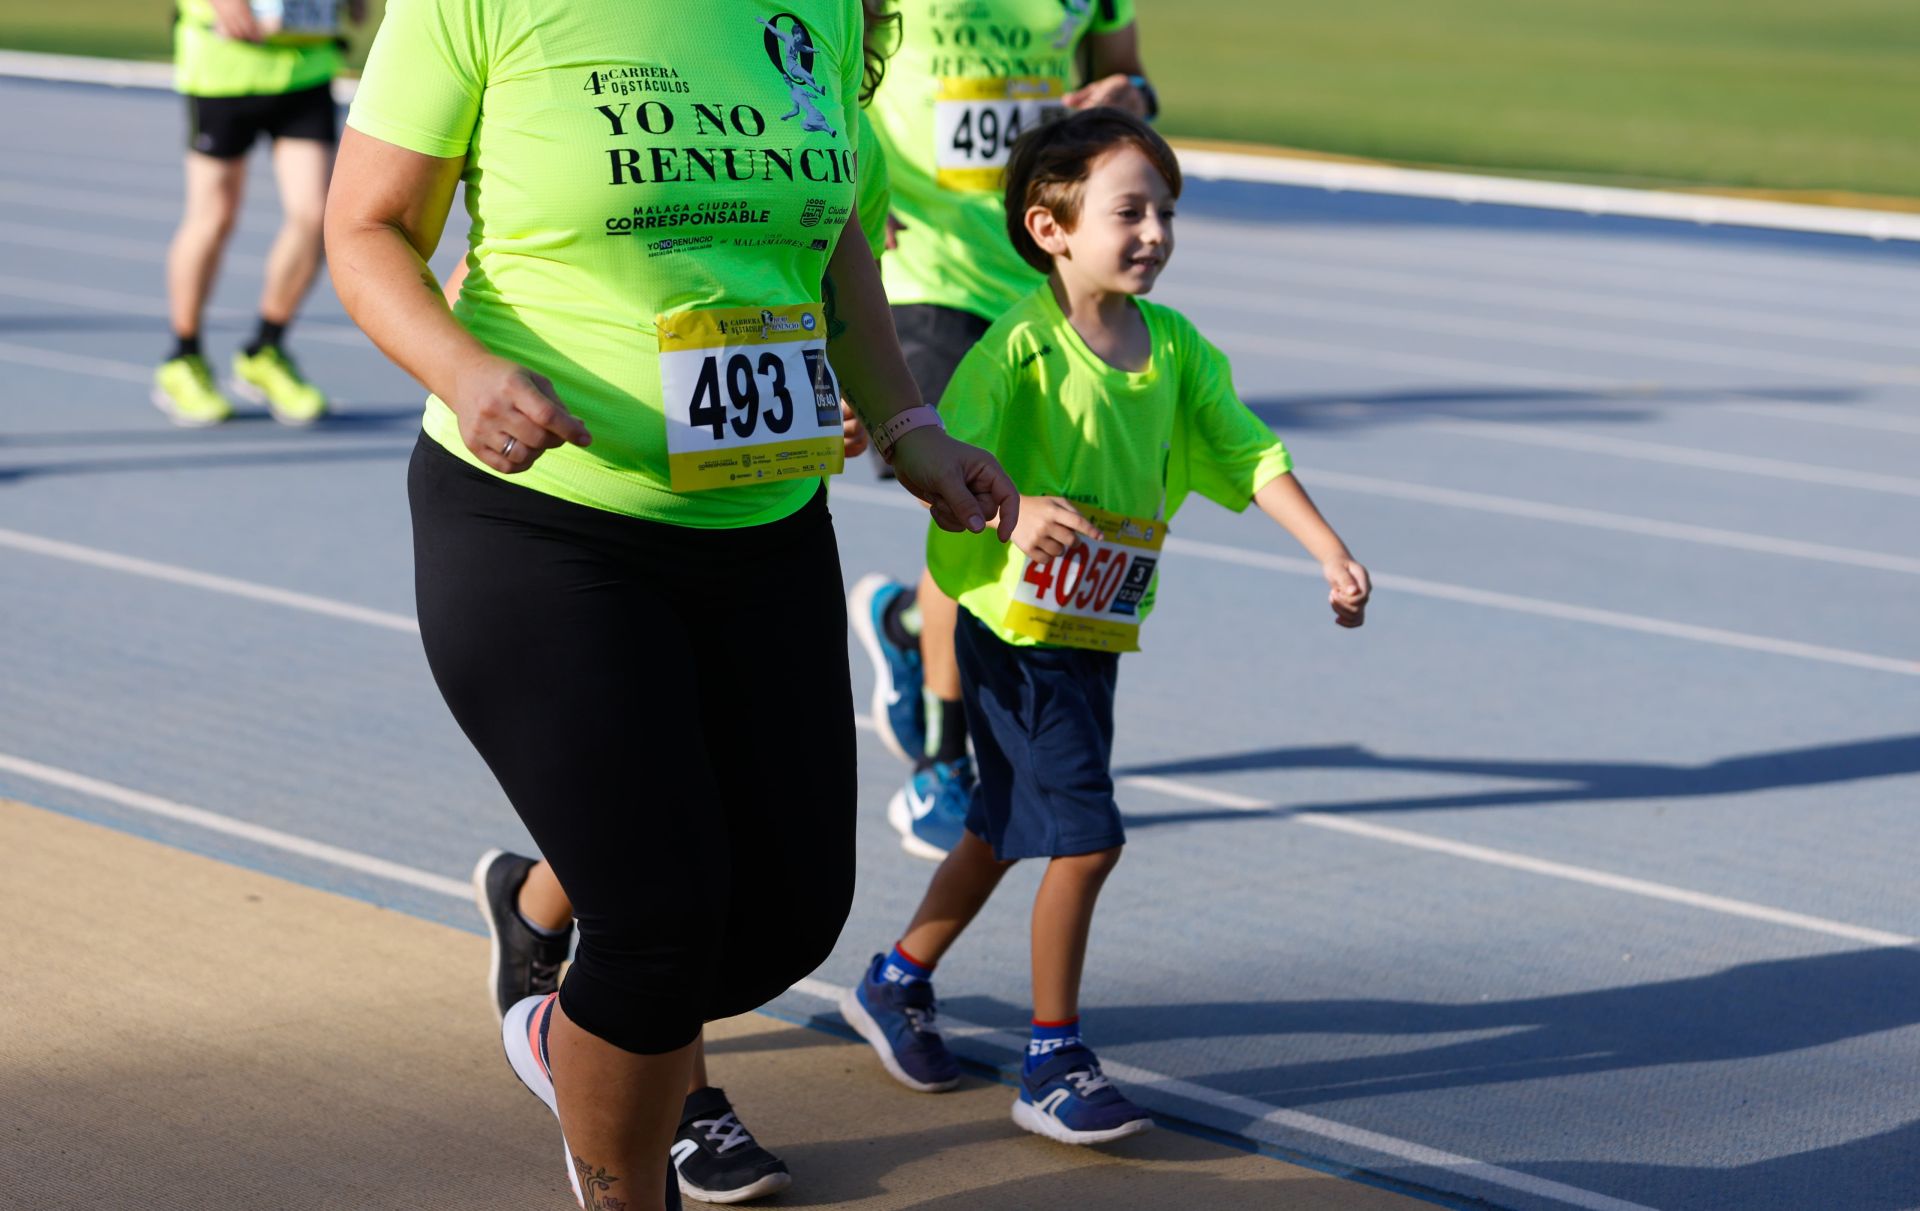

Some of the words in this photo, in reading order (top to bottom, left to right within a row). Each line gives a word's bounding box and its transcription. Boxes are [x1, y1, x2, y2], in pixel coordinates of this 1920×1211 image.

[608, 67, 679, 79] CARRERA
[611, 78, 690, 96] OBSTÁCULOS
[594, 101, 674, 136] YO
[690, 103, 765, 137] NO
[953, 106, 1022, 160] 494
[604, 147, 857, 185] RENUNCIO
[605, 210, 771, 231] CORRESPONSABLE
[697, 200, 748, 211] CIUDAD
[688, 351, 795, 441] 493
[1023, 542, 1128, 613] 4050
